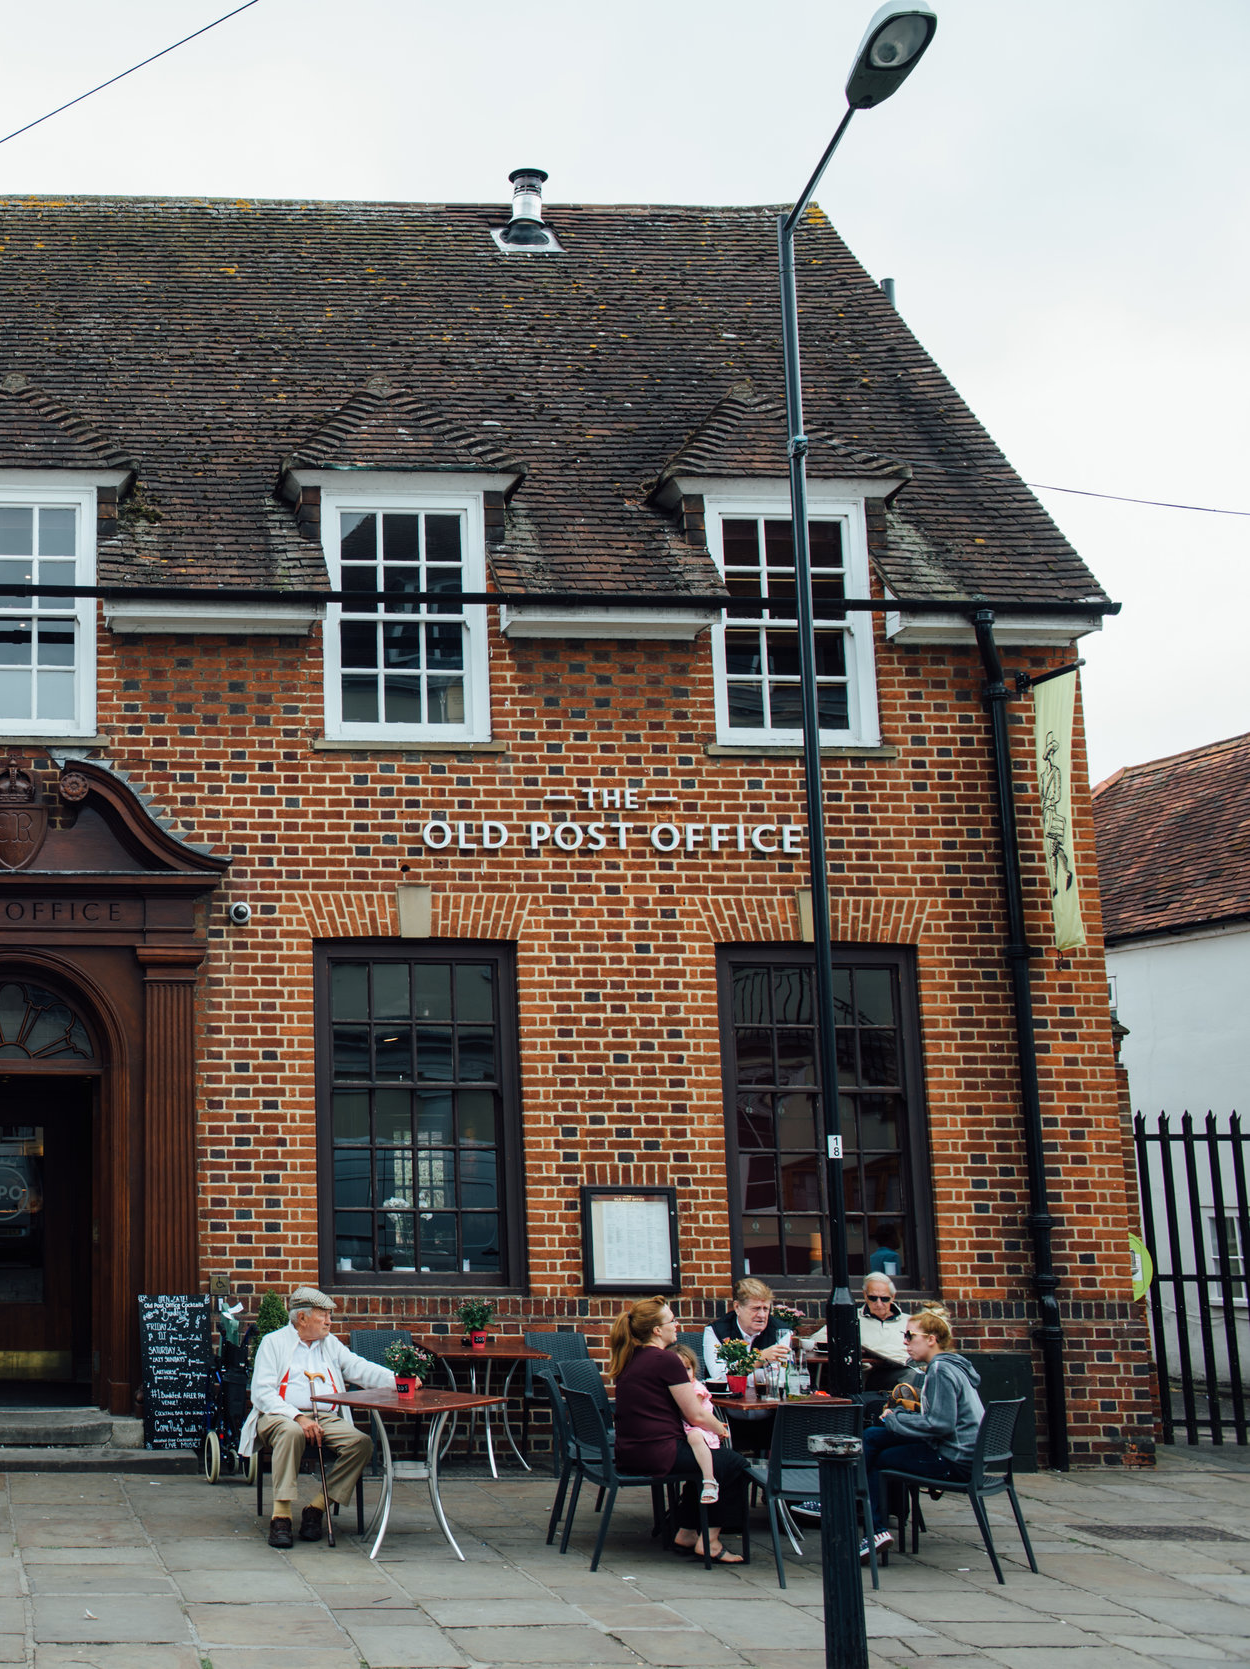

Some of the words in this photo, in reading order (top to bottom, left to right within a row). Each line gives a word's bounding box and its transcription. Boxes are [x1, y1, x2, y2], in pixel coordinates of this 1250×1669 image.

[582, 788, 639, 810] THE
[423, 820, 510, 850] OLD
[531, 821, 634, 852] POST
[651, 822, 803, 854] OFFICE
[5, 902, 122, 922] OFFICE
[148, 1346, 176, 1354] SATURDAY
